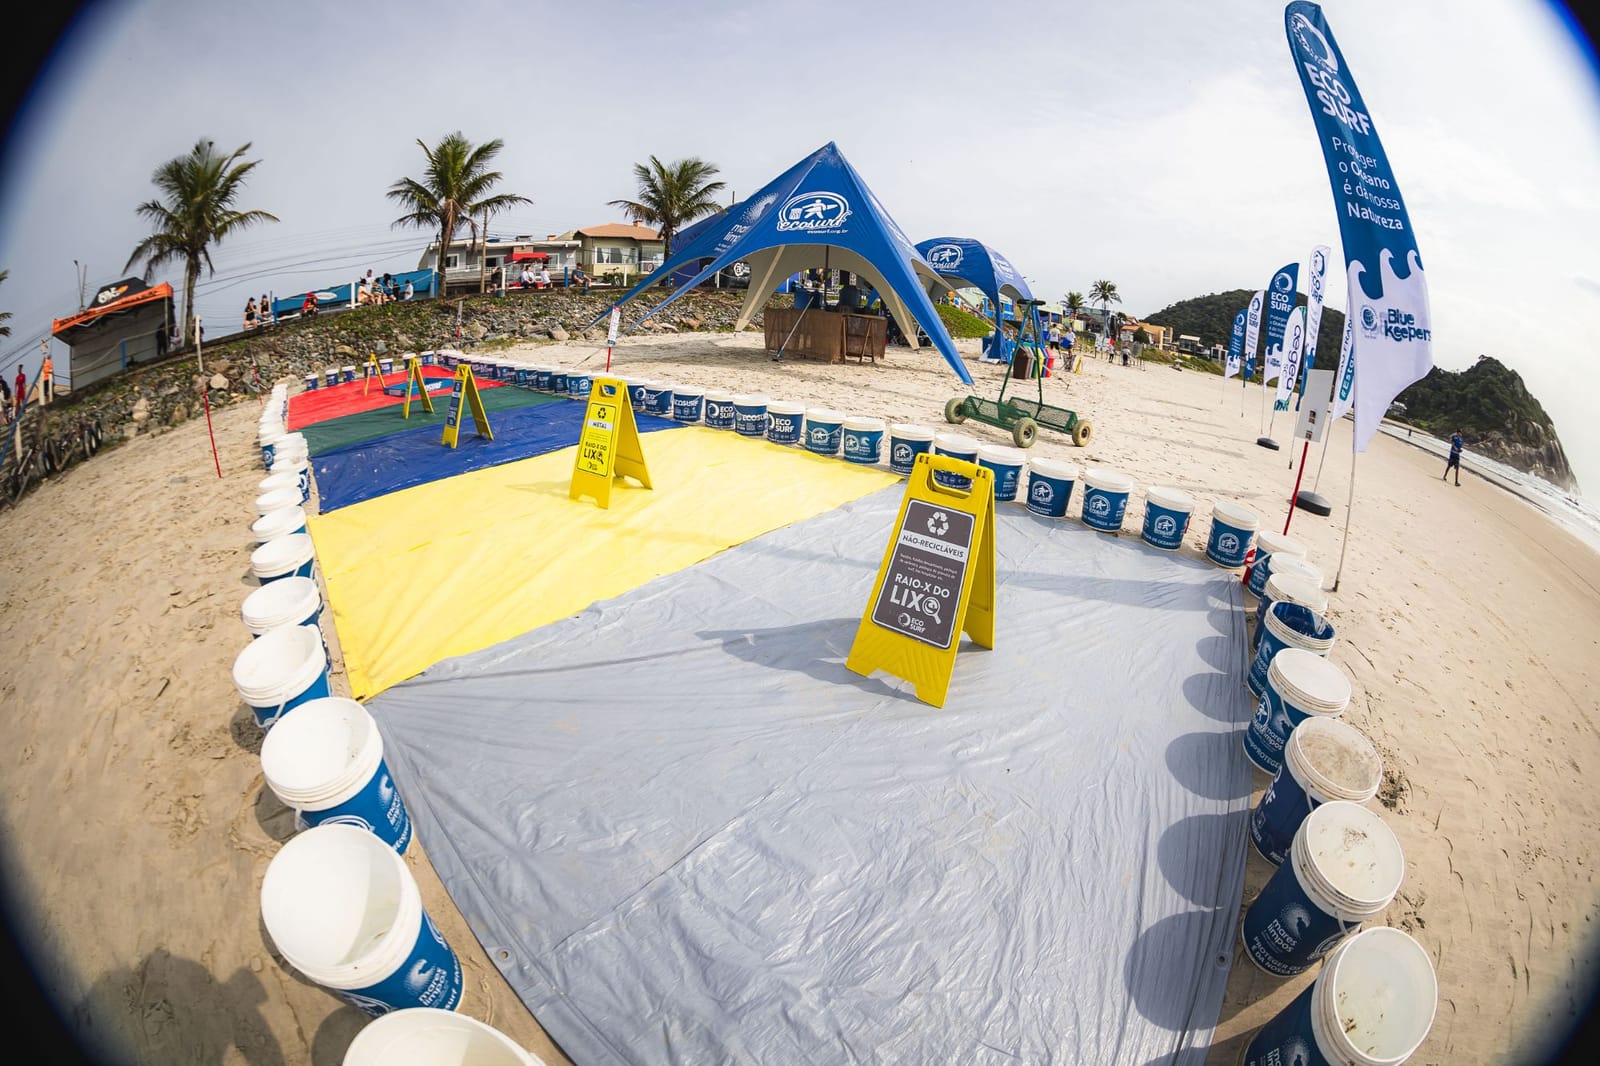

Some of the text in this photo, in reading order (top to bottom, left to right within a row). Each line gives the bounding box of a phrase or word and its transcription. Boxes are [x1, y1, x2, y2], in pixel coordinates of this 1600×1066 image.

[1303, 62, 1351, 105] ECO
[1316, 89, 1370, 136] SURF
[1338, 161, 1348, 173] o
[1343, 178, 1353, 195] é
[776, 209, 853, 232] ecosurf
[1347, 201, 1404, 230] Natureza
[1270, 291, 1289, 303] ECO
[1270, 300, 1293, 313] SURF
[1387, 308, 1415, 325] Blue
[775, 418, 792, 426] ECO
[775, 425, 795, 433] SURF
[894, 573, 932, 593] RAIO-X
[932, 585, 951, 599] DO
[910, 623, 926, 634] SURF
[911, 617, 925, 626] ECO
[1267, 923, 1295, 953] limpos
[1273, 919, 1298, 946] mares
[418, 966, 442, 1001] mares
[422, 970, 447, 1006] limpos
